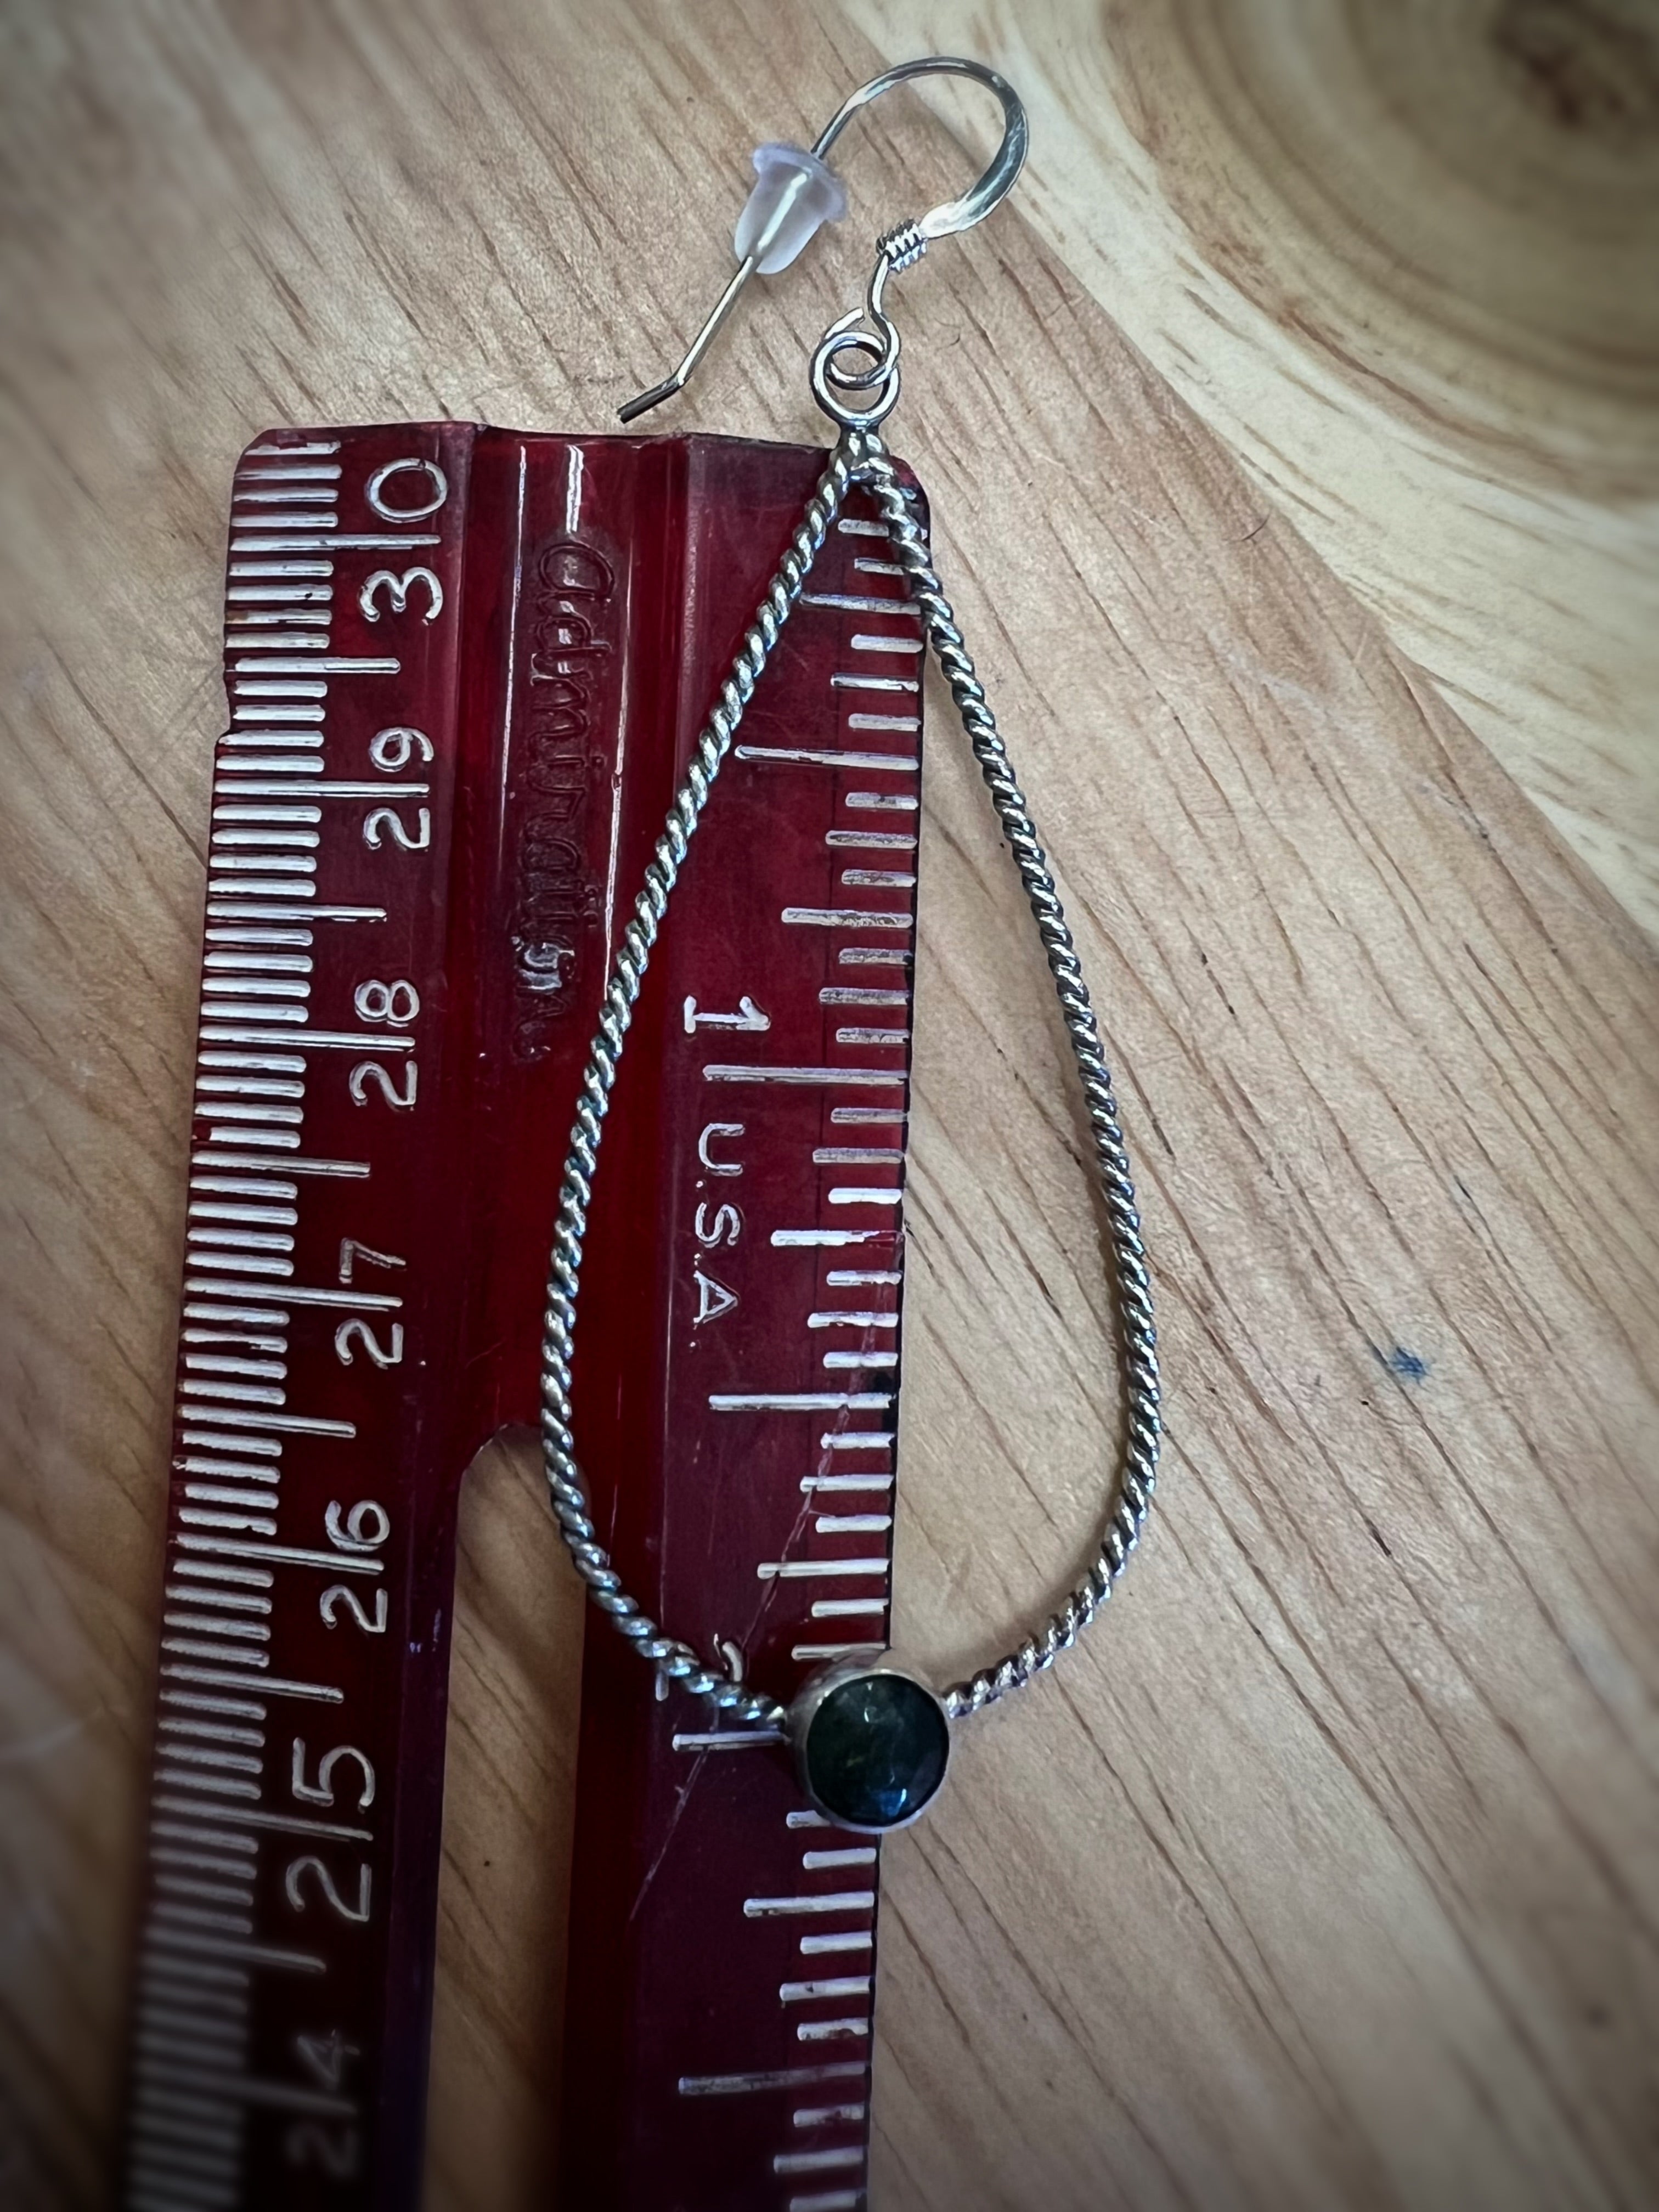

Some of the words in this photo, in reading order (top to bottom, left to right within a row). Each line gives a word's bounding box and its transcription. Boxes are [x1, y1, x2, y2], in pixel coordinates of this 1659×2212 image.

[359, 458, 448, 624] 30
[363, 727, 434, 852] 29
[348, 979, 421, 1111] 28
[684, 995, 770, 1034] 1
[335, 1237, 407, 1369] 27
[689, 1123, 745, 1349] U.S.A.
[320, 1499, 390, 1633] 26
[285, 1737, 376, 1922] 25
[285, 2029, 361, 2178] 24
